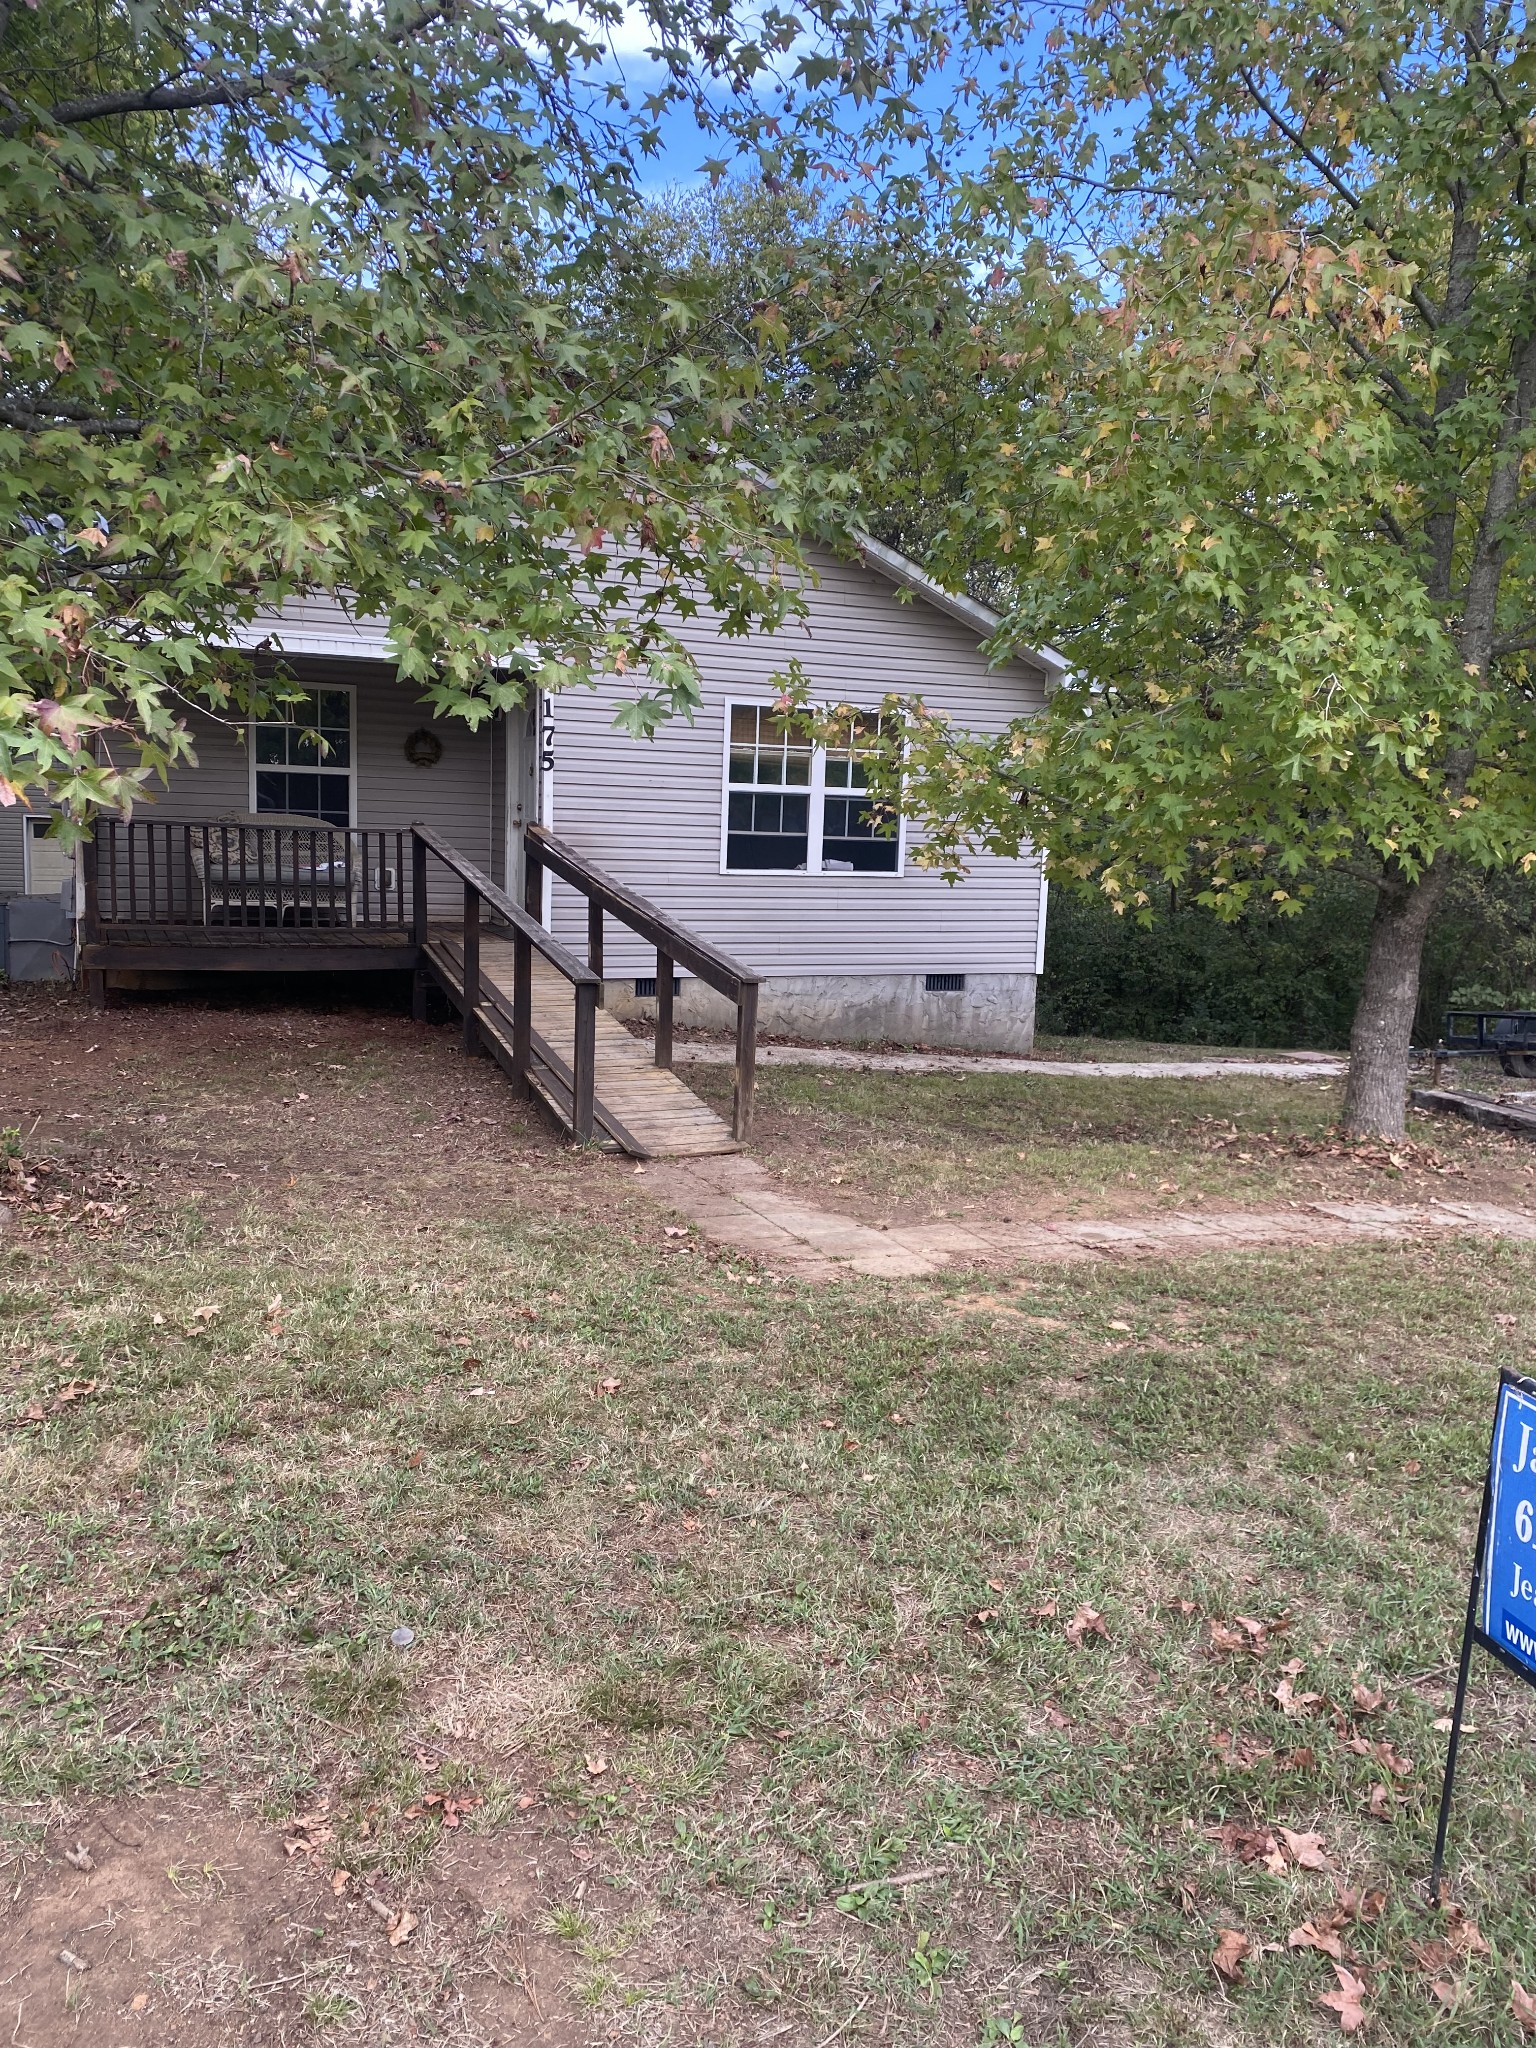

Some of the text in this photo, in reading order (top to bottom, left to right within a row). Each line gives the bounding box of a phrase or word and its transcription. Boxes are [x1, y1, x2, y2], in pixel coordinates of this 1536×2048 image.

[540, 698, 555, 771] 175
[1515, 1499, 1536, 1550] 6
[1510, 1561, 1536, 1606] Je
[1505, 1619, 1536, 1661] ww
